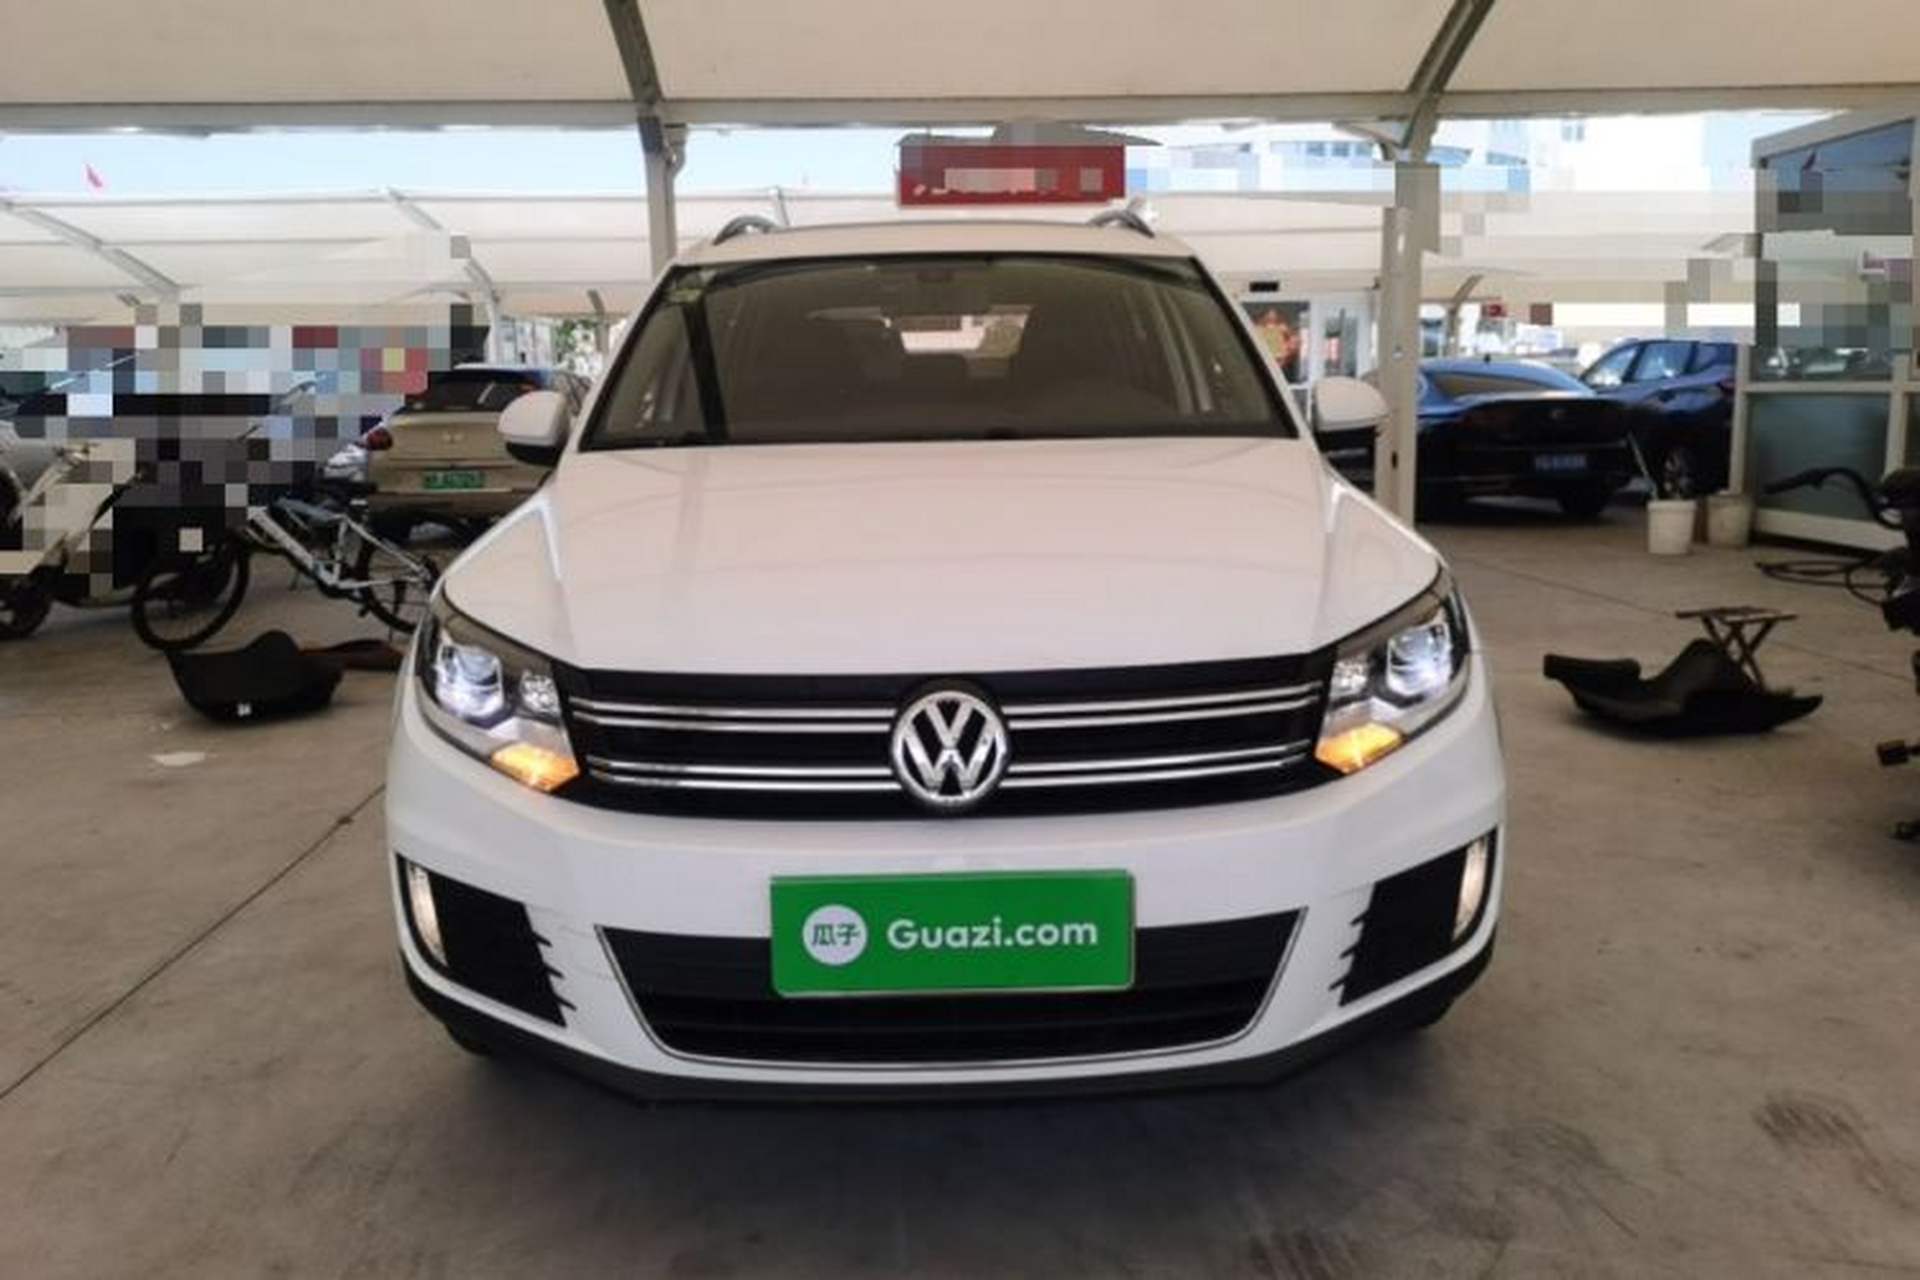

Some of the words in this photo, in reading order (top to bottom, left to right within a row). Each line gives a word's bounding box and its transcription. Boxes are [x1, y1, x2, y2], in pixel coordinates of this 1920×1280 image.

[893, 690, 1006, 801] VW
[811, 923, 861, 947] 瓜子
[887, 917, 1098, 950] Guazi.com
